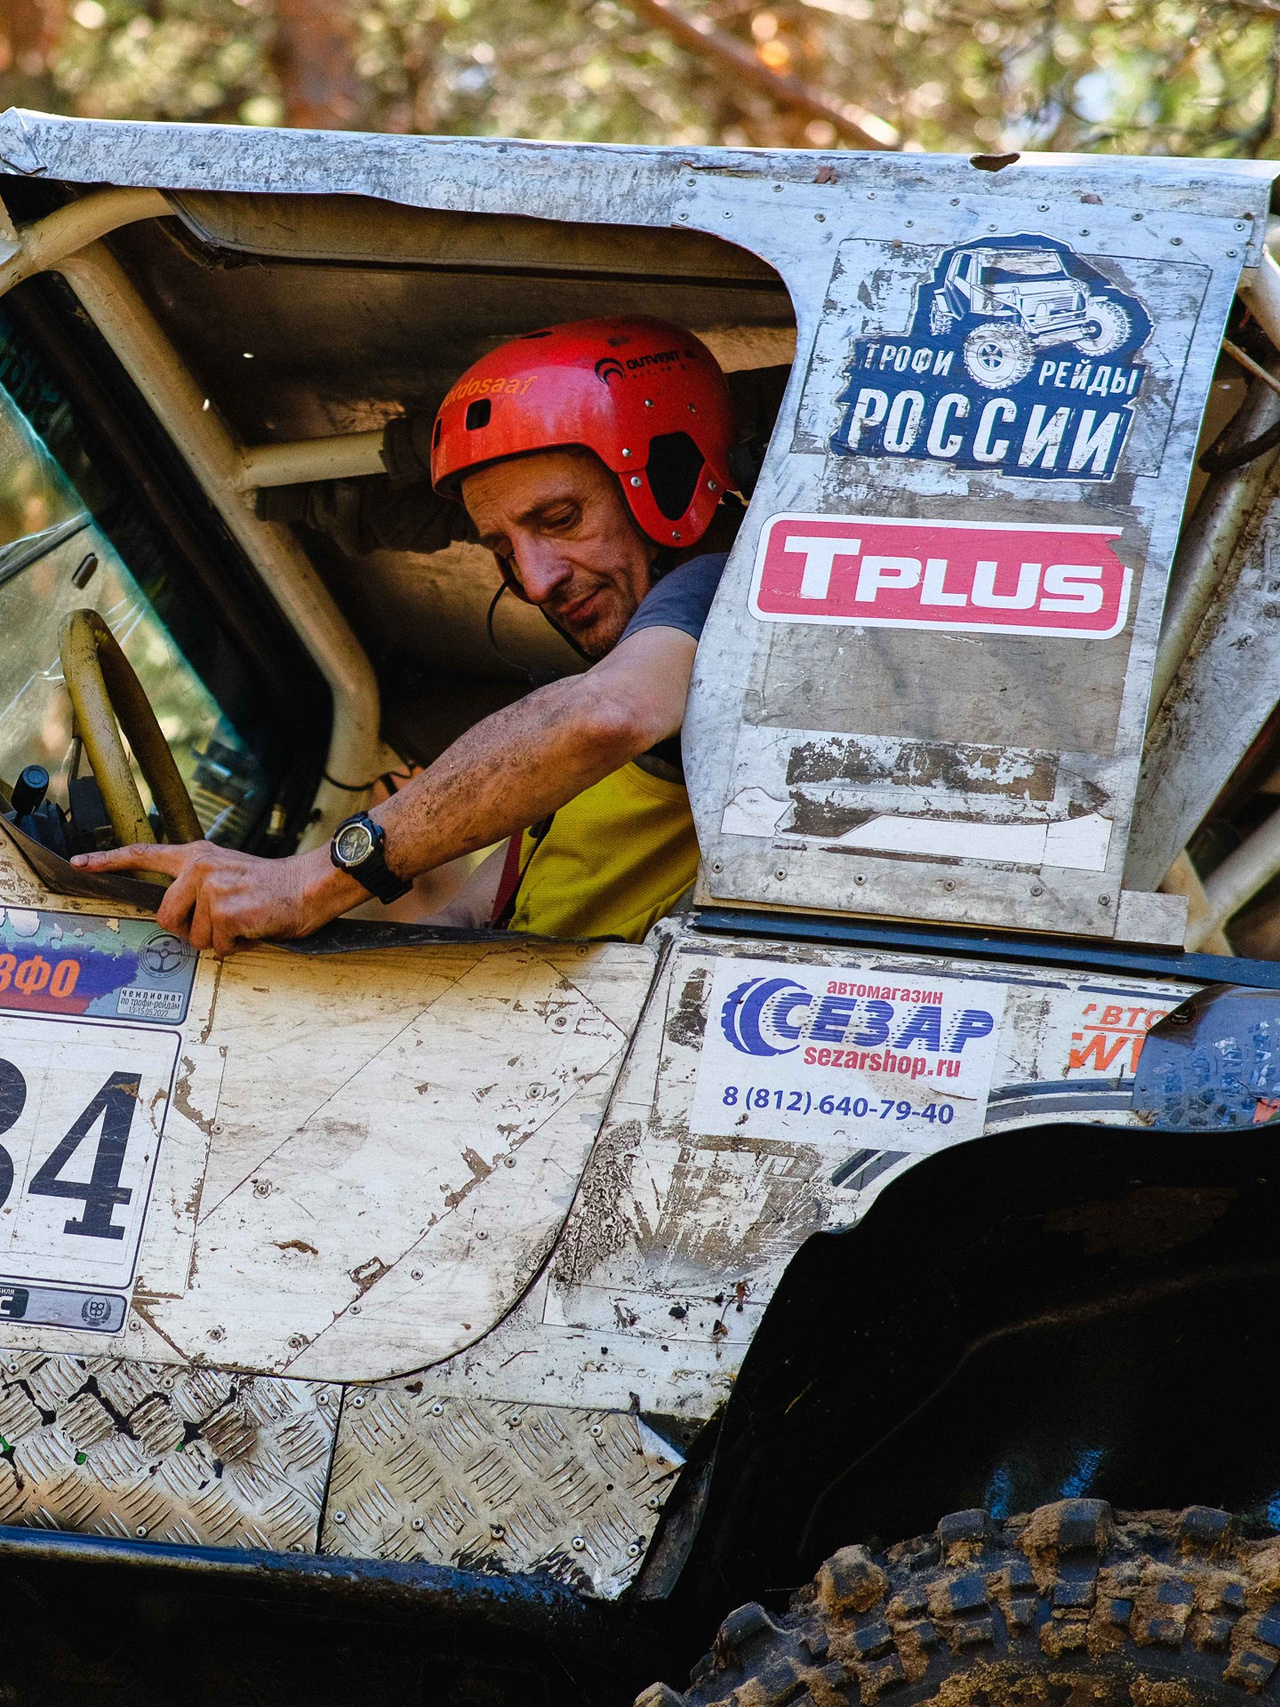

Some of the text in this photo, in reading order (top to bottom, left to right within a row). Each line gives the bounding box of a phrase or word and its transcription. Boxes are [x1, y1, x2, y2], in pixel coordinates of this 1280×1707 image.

[864, 343, 1139, 397] ТРОФИ РЕЙДЫ
[847, 388, 1121, 475] РОССИИ
[783, 535, 1105, 614] TPLUS
[122, 989, 182, 1003] чемпионат
[131, 998, 180, 1011] трофи-рейдам
[827, 980, 944, 1005] автомагазин
[761, 990, 994, 1053] СЕЗАР
[803, 1046, 961, 1079] sezarshop.ru
[722, 1086, 955, 1125] 8 (812) 640-79-40
